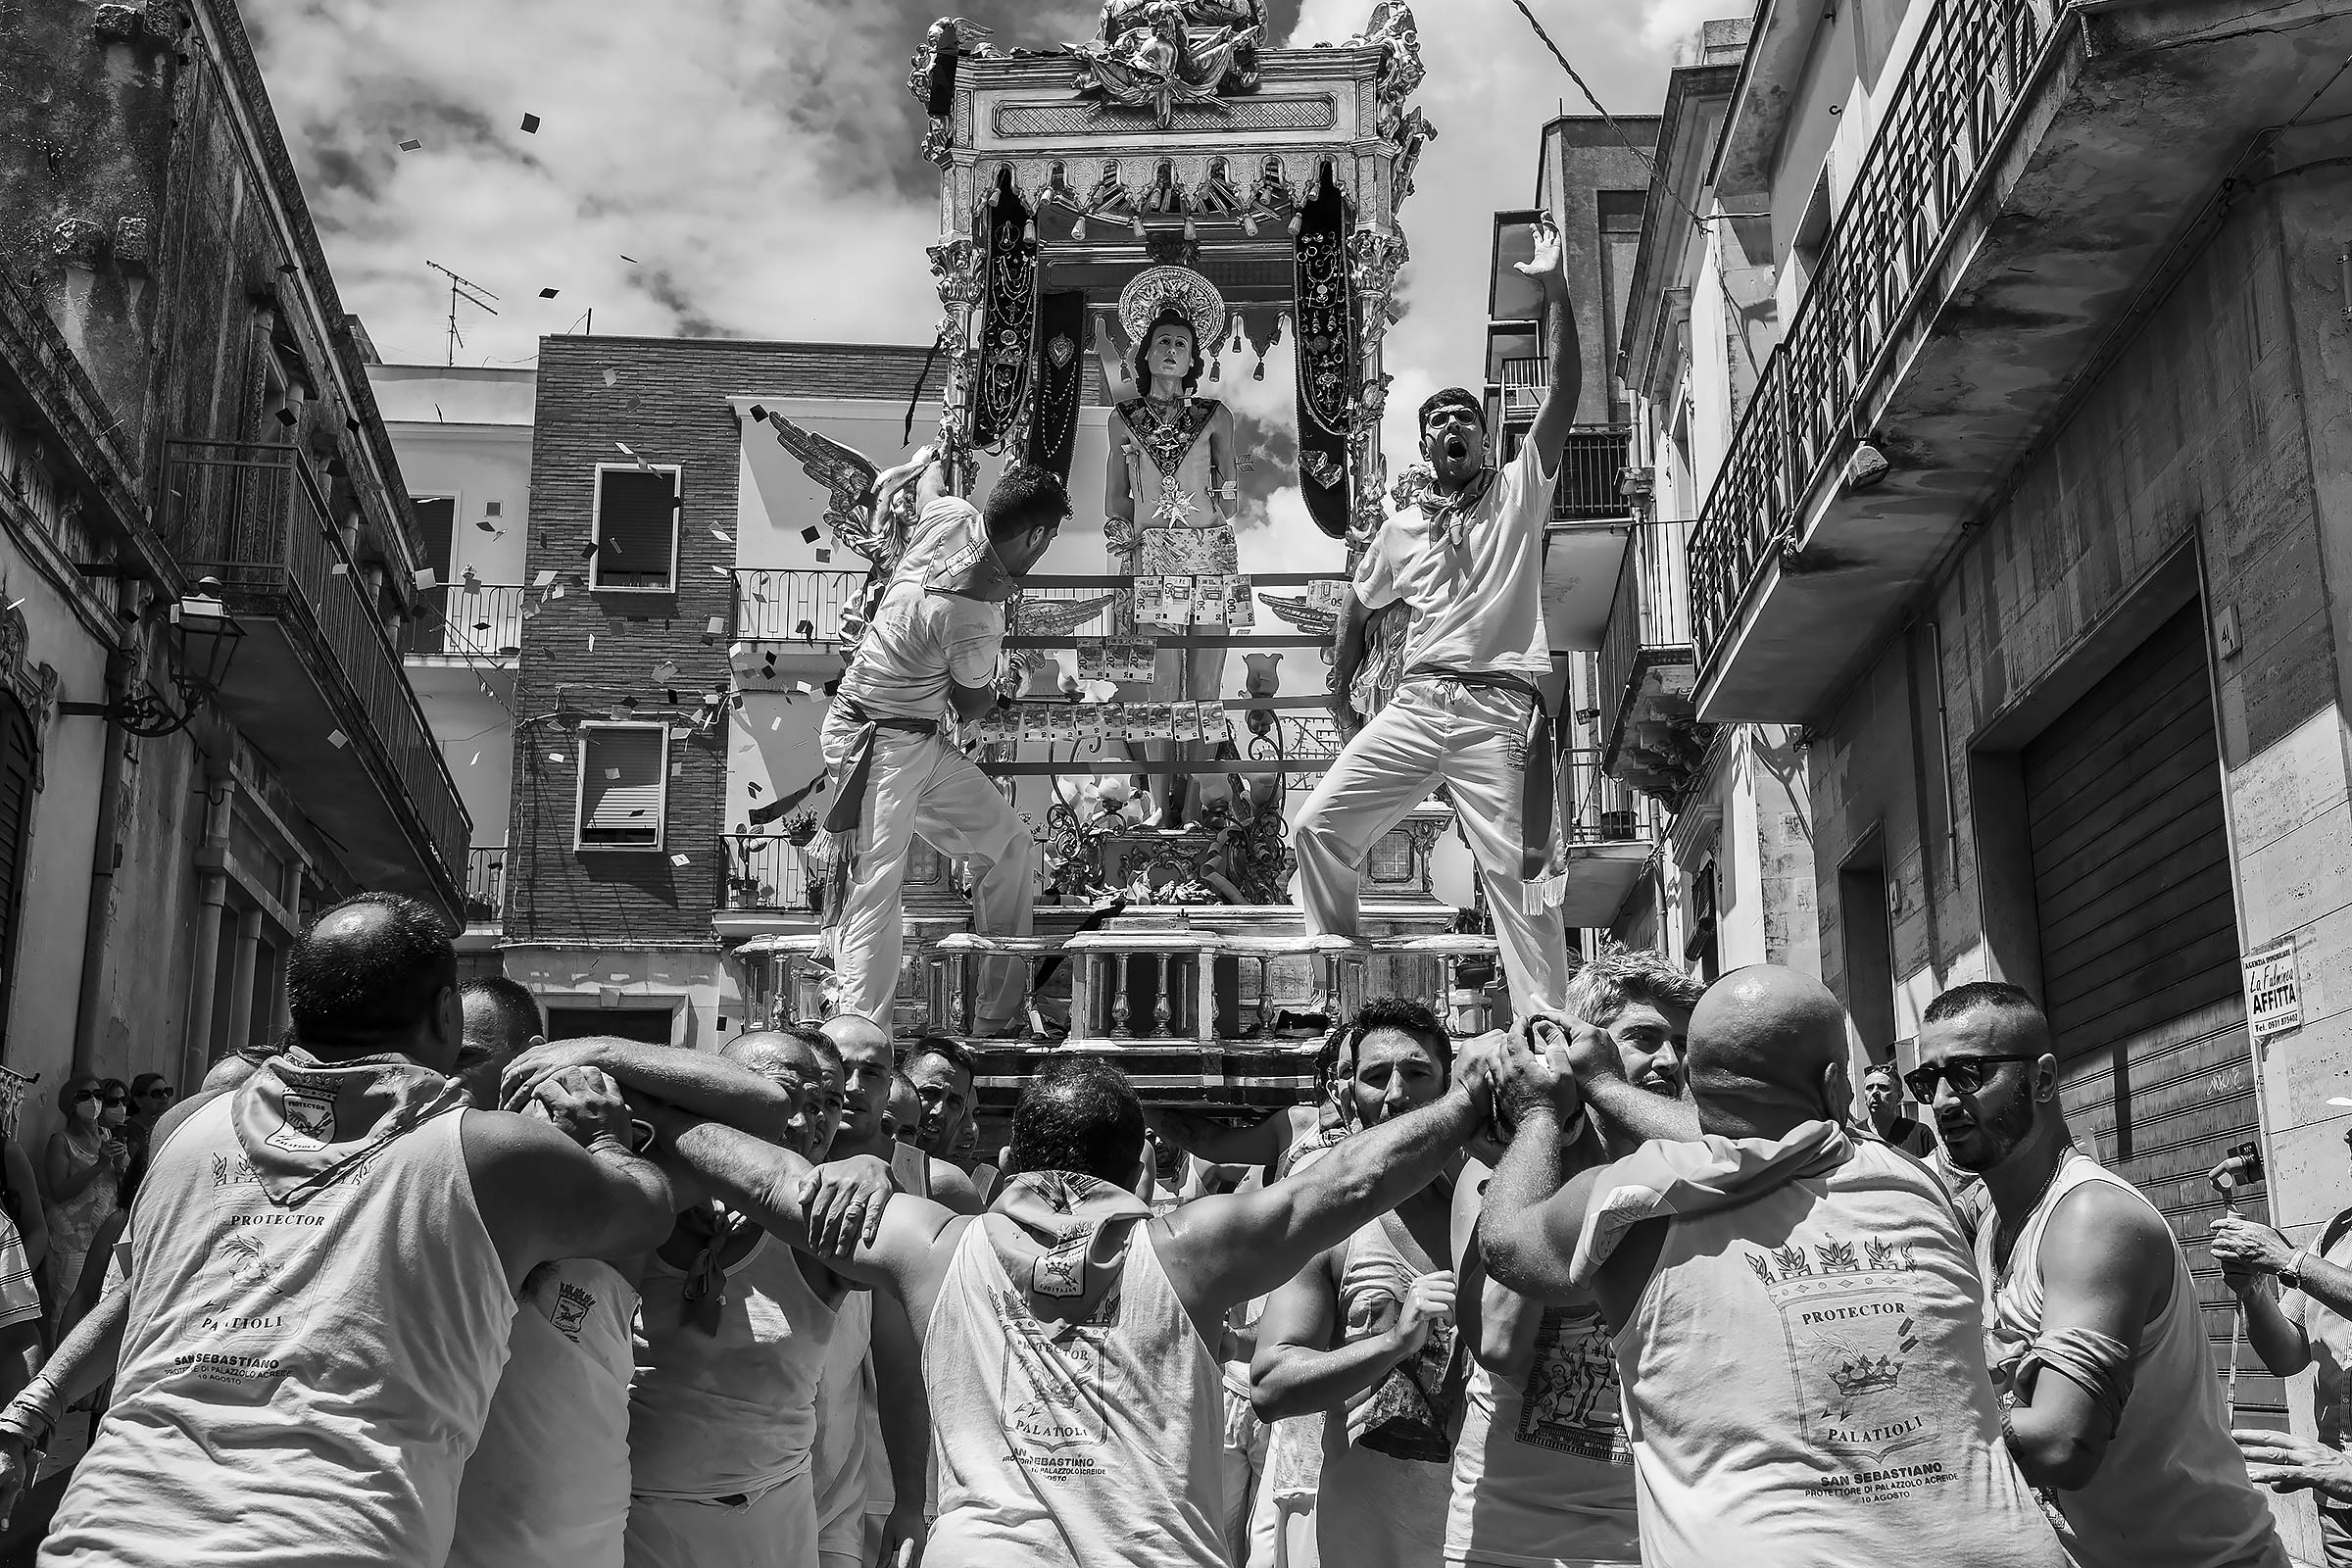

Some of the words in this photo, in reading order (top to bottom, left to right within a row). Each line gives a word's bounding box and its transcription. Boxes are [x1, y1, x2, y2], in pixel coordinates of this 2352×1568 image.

[1165, 582, 1174, 595] 50
[1137, 598, 1146, 610] 50
[1197, 600, 1205, 611] 50
[1227, 598, 1237, 614] 100
[1331, 598, 1343, 608] 50
[1079, 659, 1088, 669] 20
[1106, 657, 1115, 668] 20
[1130, 657, 1139, 668] 20
[1127, 716, 1134, 725] 10
[1150, 717, 1156, 727] 10
[1176, 718, 1184, 728] 10
[1202, 718, 1211, 728] 10
[2245, 957, 2266, 970] AGENZIA
[2250, 970, 2262, 993] La
[2253, 983, 2297, 1015] AFFITTA
[2255, 1022, 2267, 1032] Tel.
[2268, 1019, 2280, 1029] 0931
[231, 1214, 325, 1226] PROTECTOR
[1801, 1302, 1906, 1325] PROTECTOR
[202, 1315, 282, 1331] PATIOLI
[174, 1354, 195, 1365] SAN
[196, 1352, 280, 1369] SEBASTIANO
[211, 1365, 256, 1379] PALAZZOLO
[257, 1369, 293, 1379] ACREIDE
[209, 1374, 242, 1386] AGOSTO
[1827, 1415, 1924, 1443] PALATIOLI
[1012, 1446, 1027, 1457] AN
[1820, 1474, 1850, 1487] SAN
[1853, 1461, 1943, 1485] SEBASTIANO
[1804, 1488, 1862, 1497] PROTETTORE
[1864, 1484, 1874, 1494] DI
[1875, 1478, 1923, 1493] PALAZZOLO
[1924, 1472, 1960, 1486] ACREIDE
[1861, 1495, 1872, 1504] 10
[1873, 1491, 1911, 1503] AGOSTO
